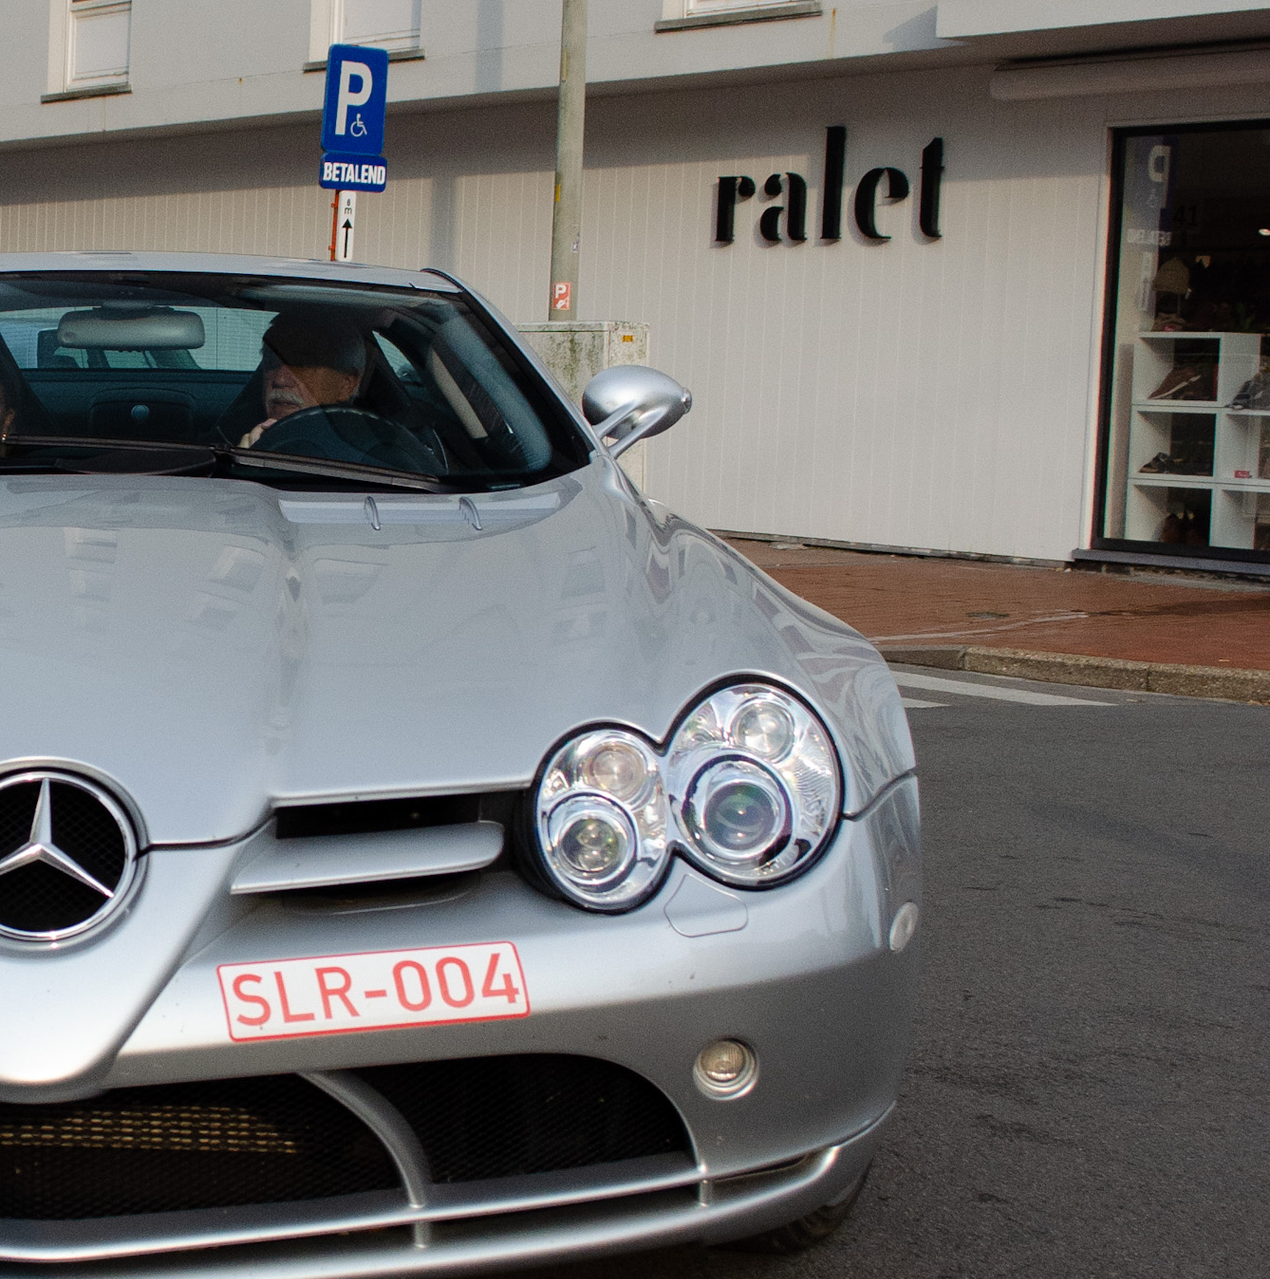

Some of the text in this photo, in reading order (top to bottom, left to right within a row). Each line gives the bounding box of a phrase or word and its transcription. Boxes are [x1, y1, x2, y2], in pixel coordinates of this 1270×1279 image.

[335, 60, 373, 135] P
[322, 162, 386, 185] BETALEND
[715, 126, 944, 241] ralet
[555, 284, 567, 299] P
[232, 953, 520, 1026] SLR-004
